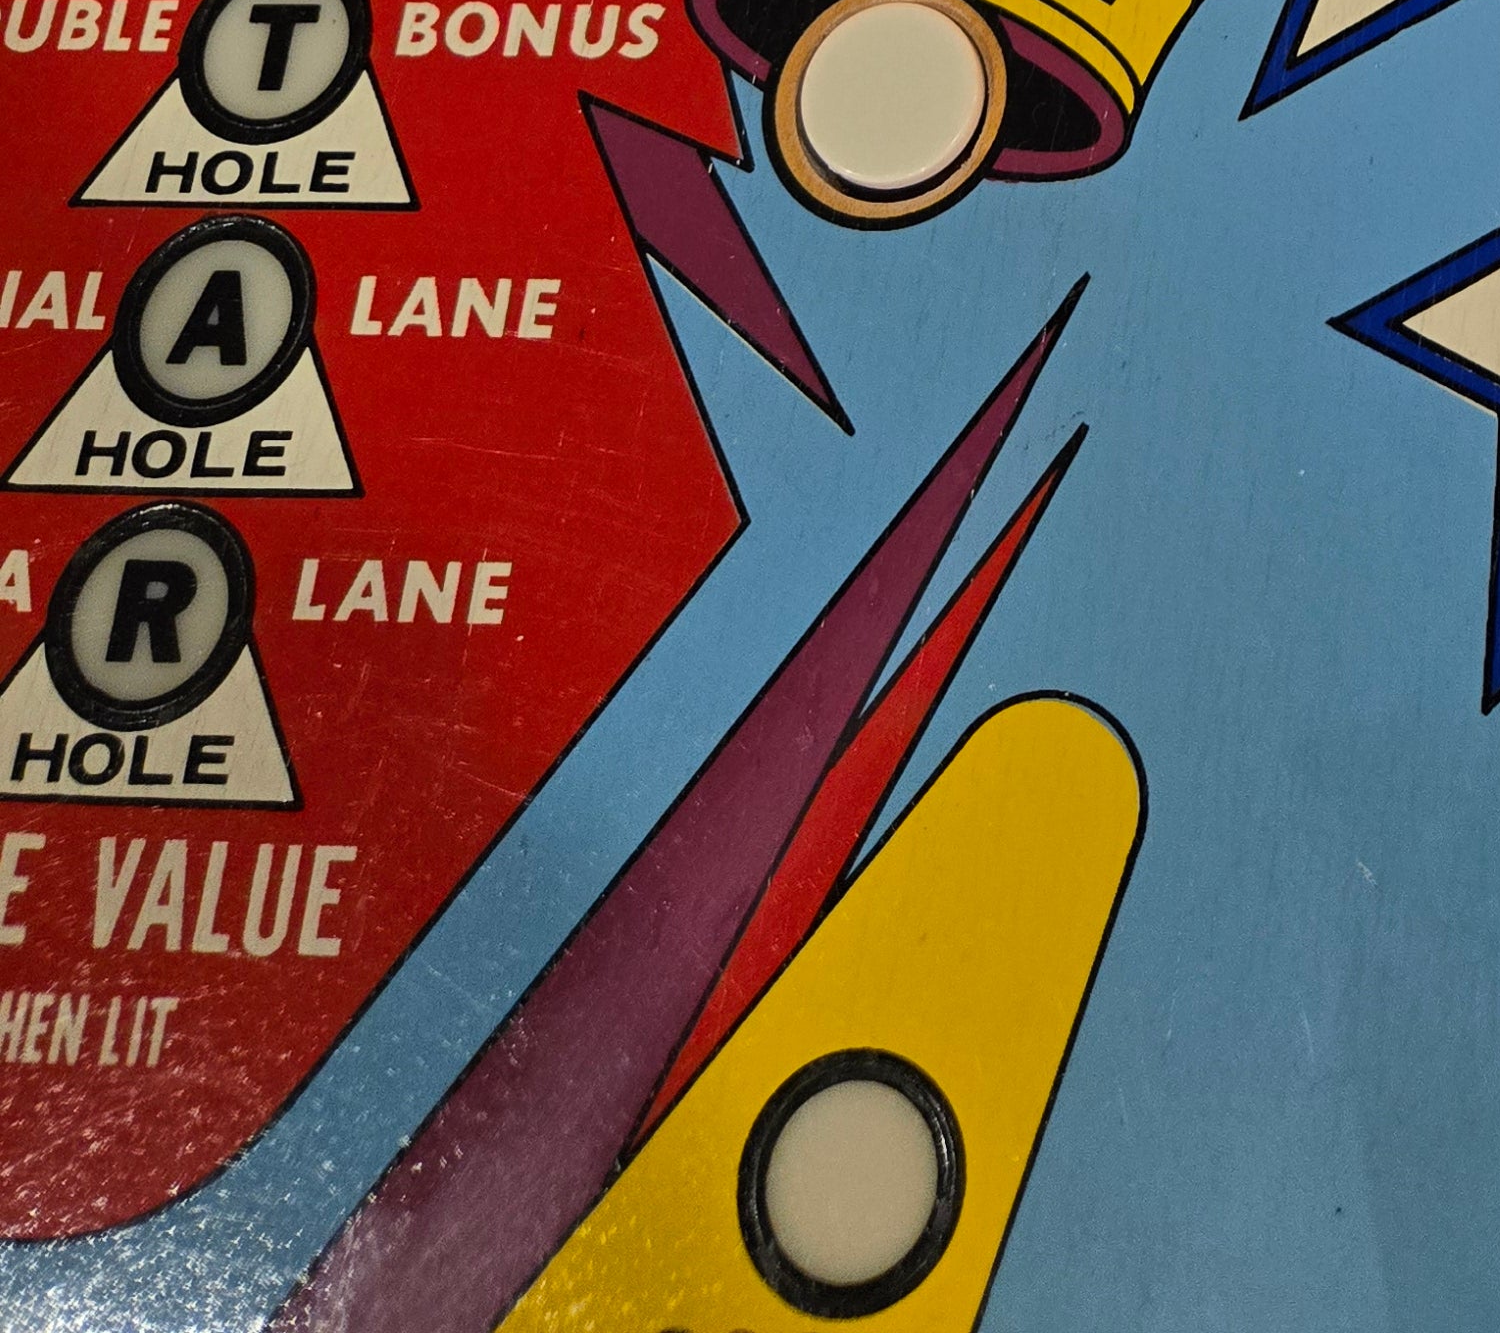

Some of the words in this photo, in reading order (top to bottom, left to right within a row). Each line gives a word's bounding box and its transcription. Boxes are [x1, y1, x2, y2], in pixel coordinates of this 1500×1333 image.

[247, 2, 323, 92] T
[394, 0, 667, 59] BONUS
[143, 150, 357, 195] HOLE
[0, 269, 107, 331] IAL
[349, 274, 562, 339] LANE
[165, 269, 248, 366] A
[74, 429, 294, 479] HOLE
[104, 558, 199, 665] R
[291, 558, 514, 626] LANE
[9, 731, 236, 787] HOLE
[91, 835, 358, 958] VALUE
[0, 989, 90, 1066] HEN
[97, 994, 181, 1069] LIT
